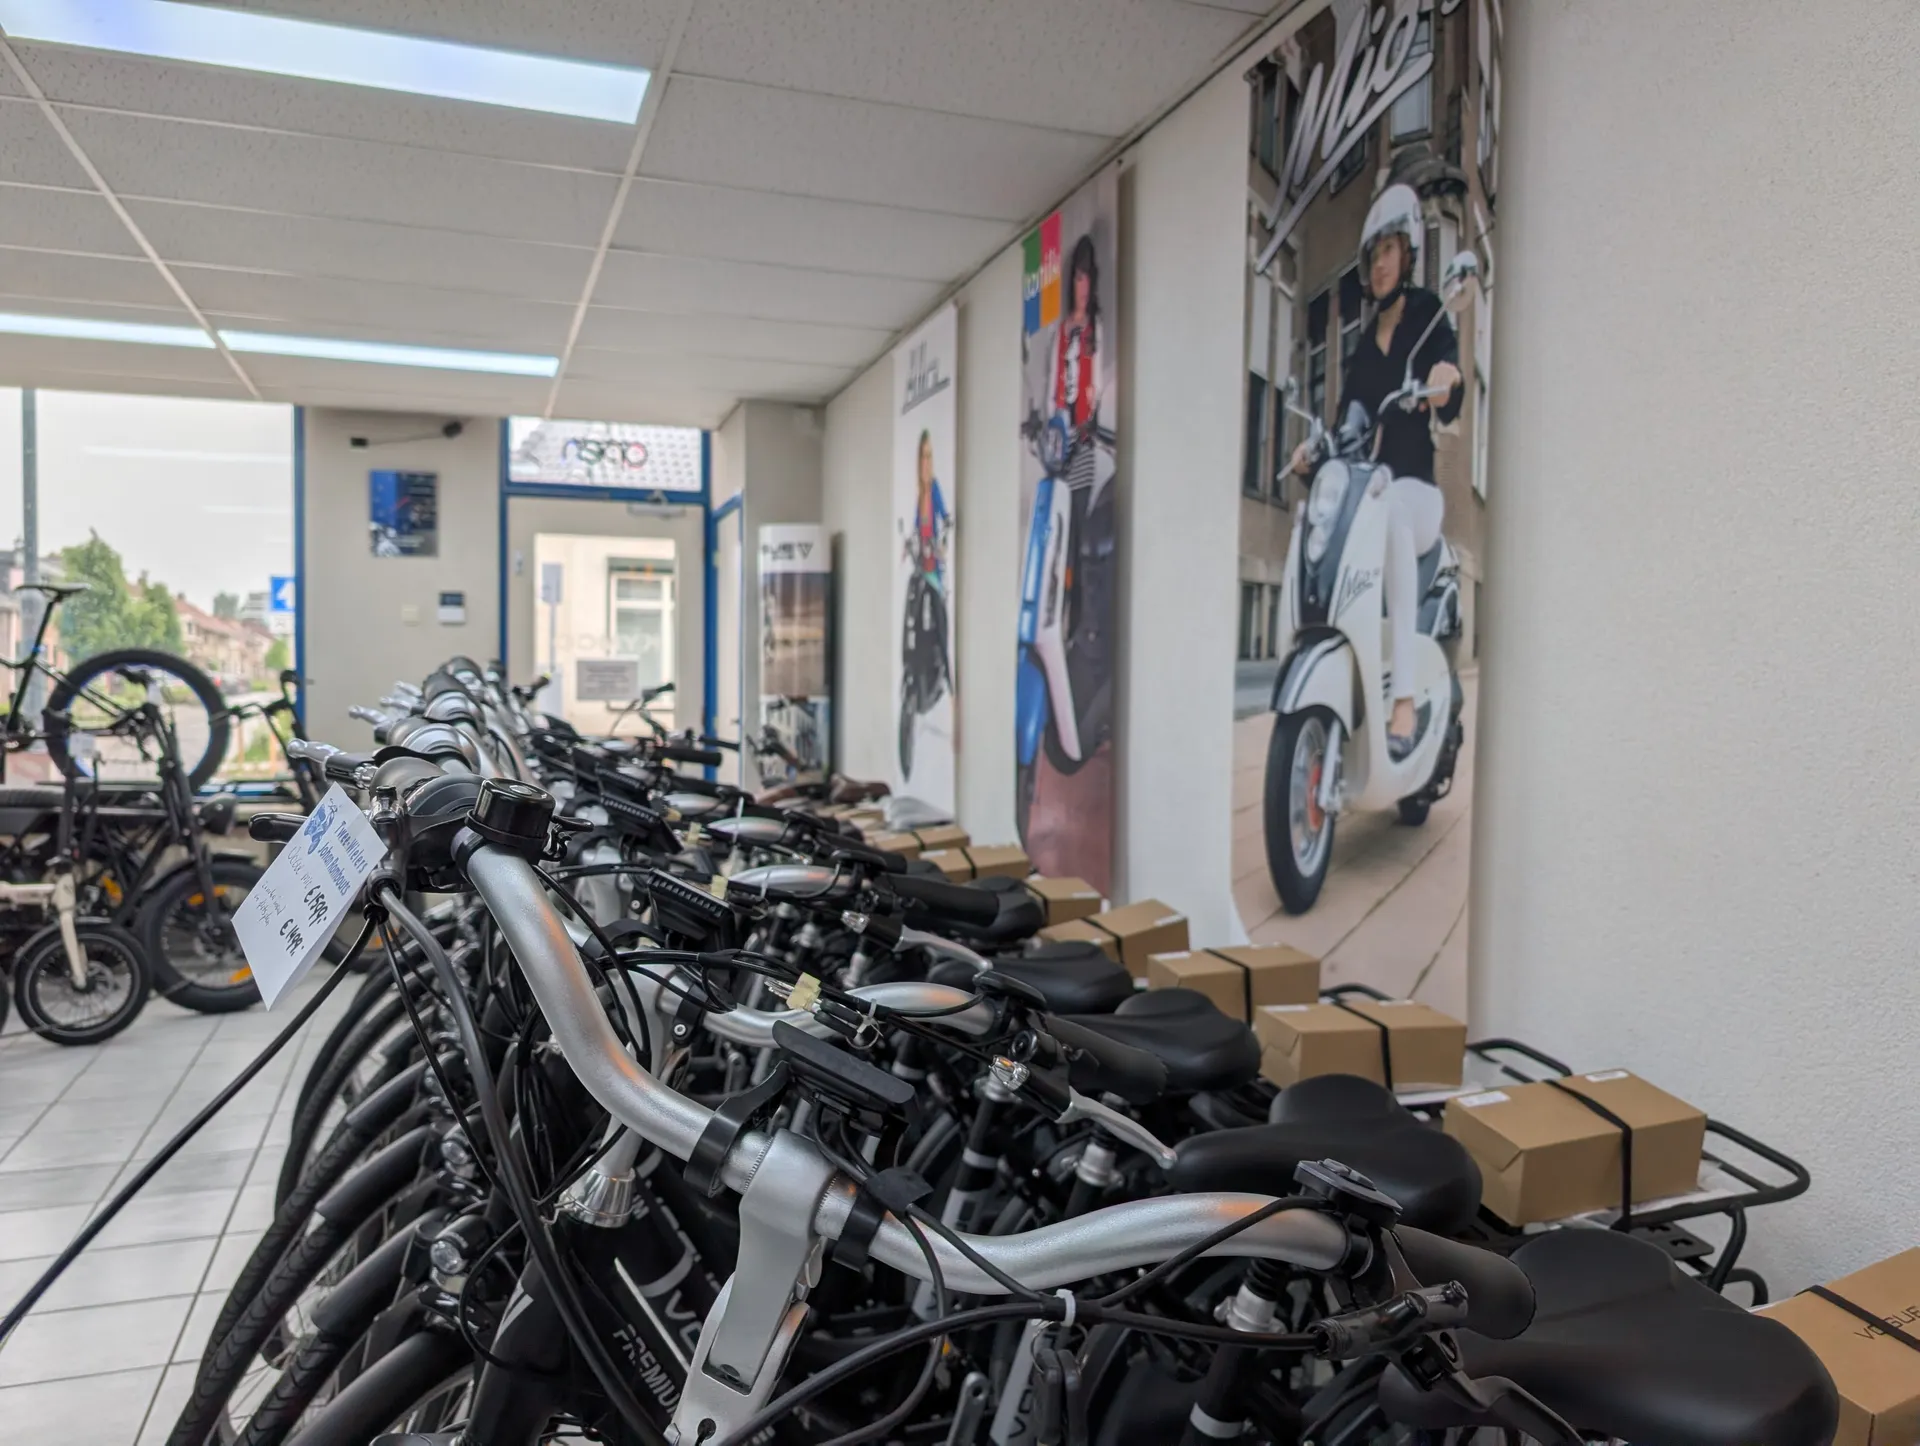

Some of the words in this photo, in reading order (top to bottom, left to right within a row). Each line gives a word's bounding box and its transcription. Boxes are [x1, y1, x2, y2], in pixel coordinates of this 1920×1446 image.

[318, 841, 337, 871] Johan
[328, 856, 351, 896] Rombouts
[613, 1323, 681, 1418] PREMIU
